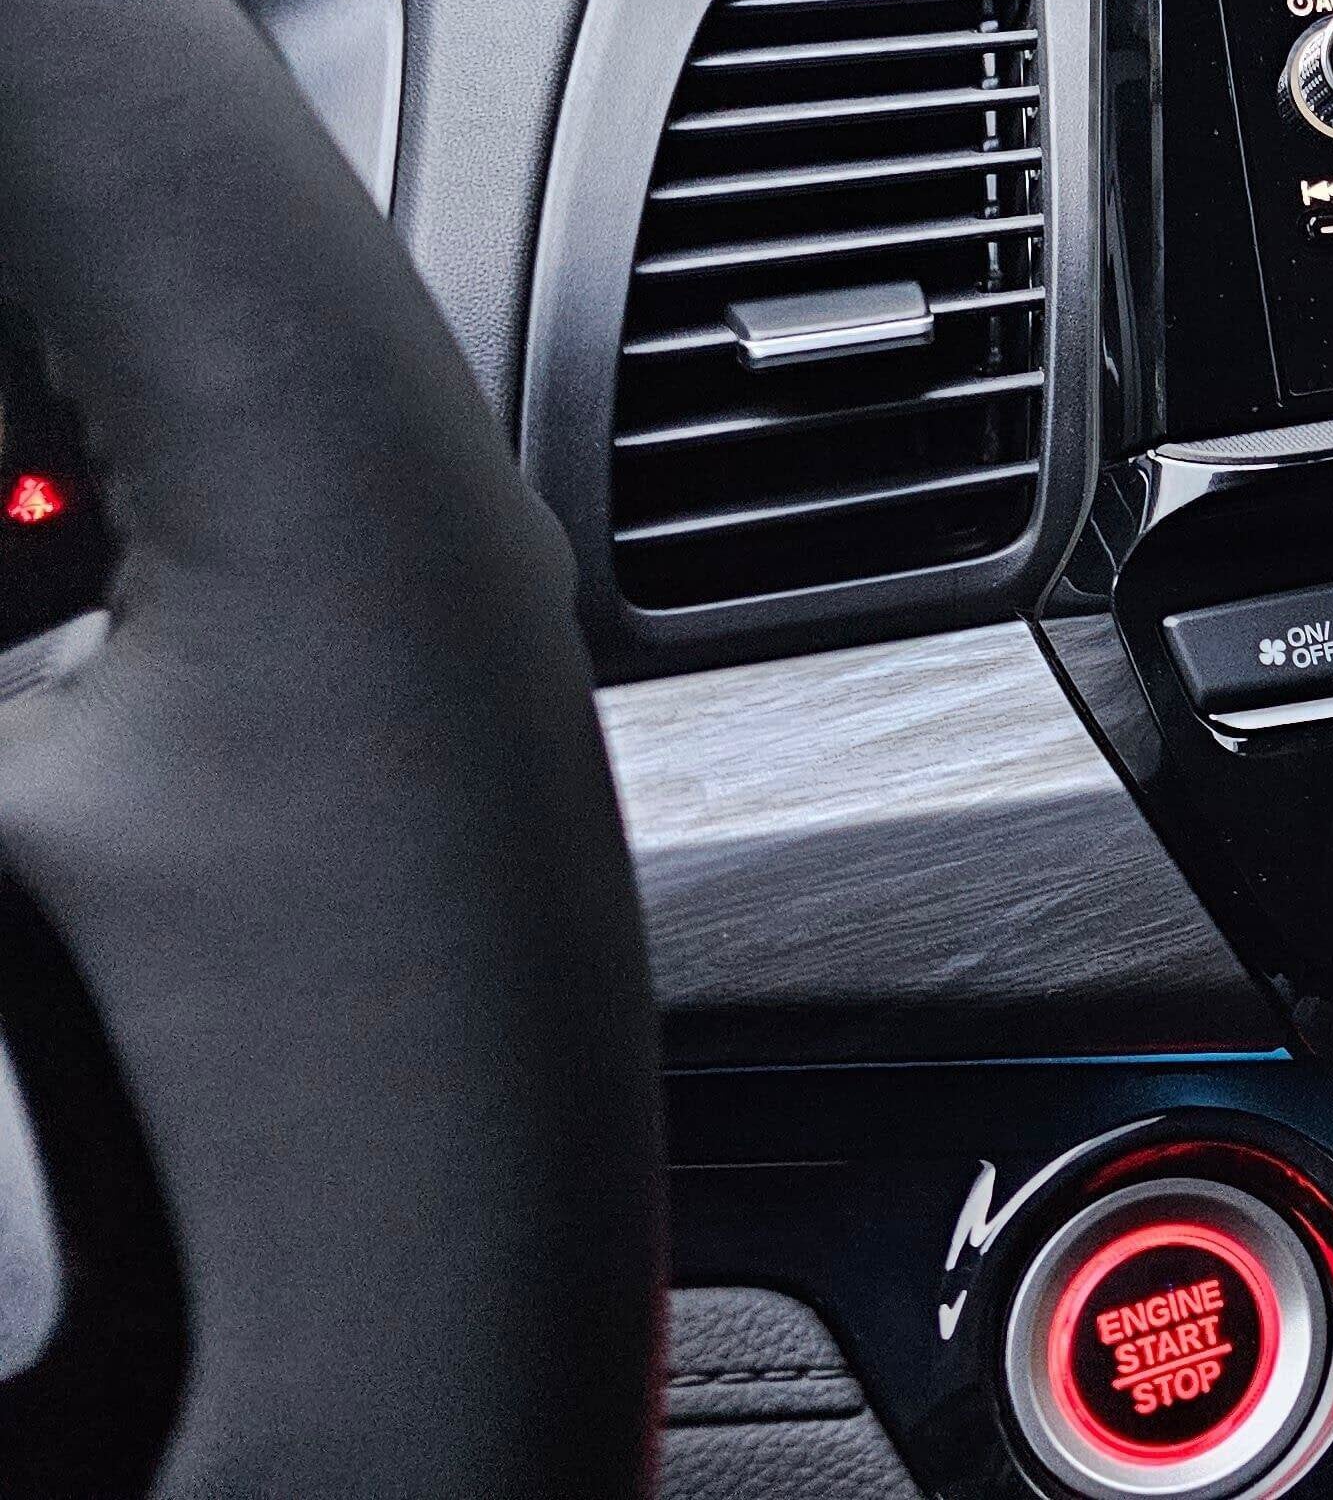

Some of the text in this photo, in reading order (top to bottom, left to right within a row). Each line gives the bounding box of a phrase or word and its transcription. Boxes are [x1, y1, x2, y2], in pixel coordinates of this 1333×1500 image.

[1287, 620, 1331, 648] ON/
[1097, 1279, 1225, 1346] ENGINE
[1115, 1316, 1224, 1375] START
[1132, 1362, 1222, 1414] STOP
